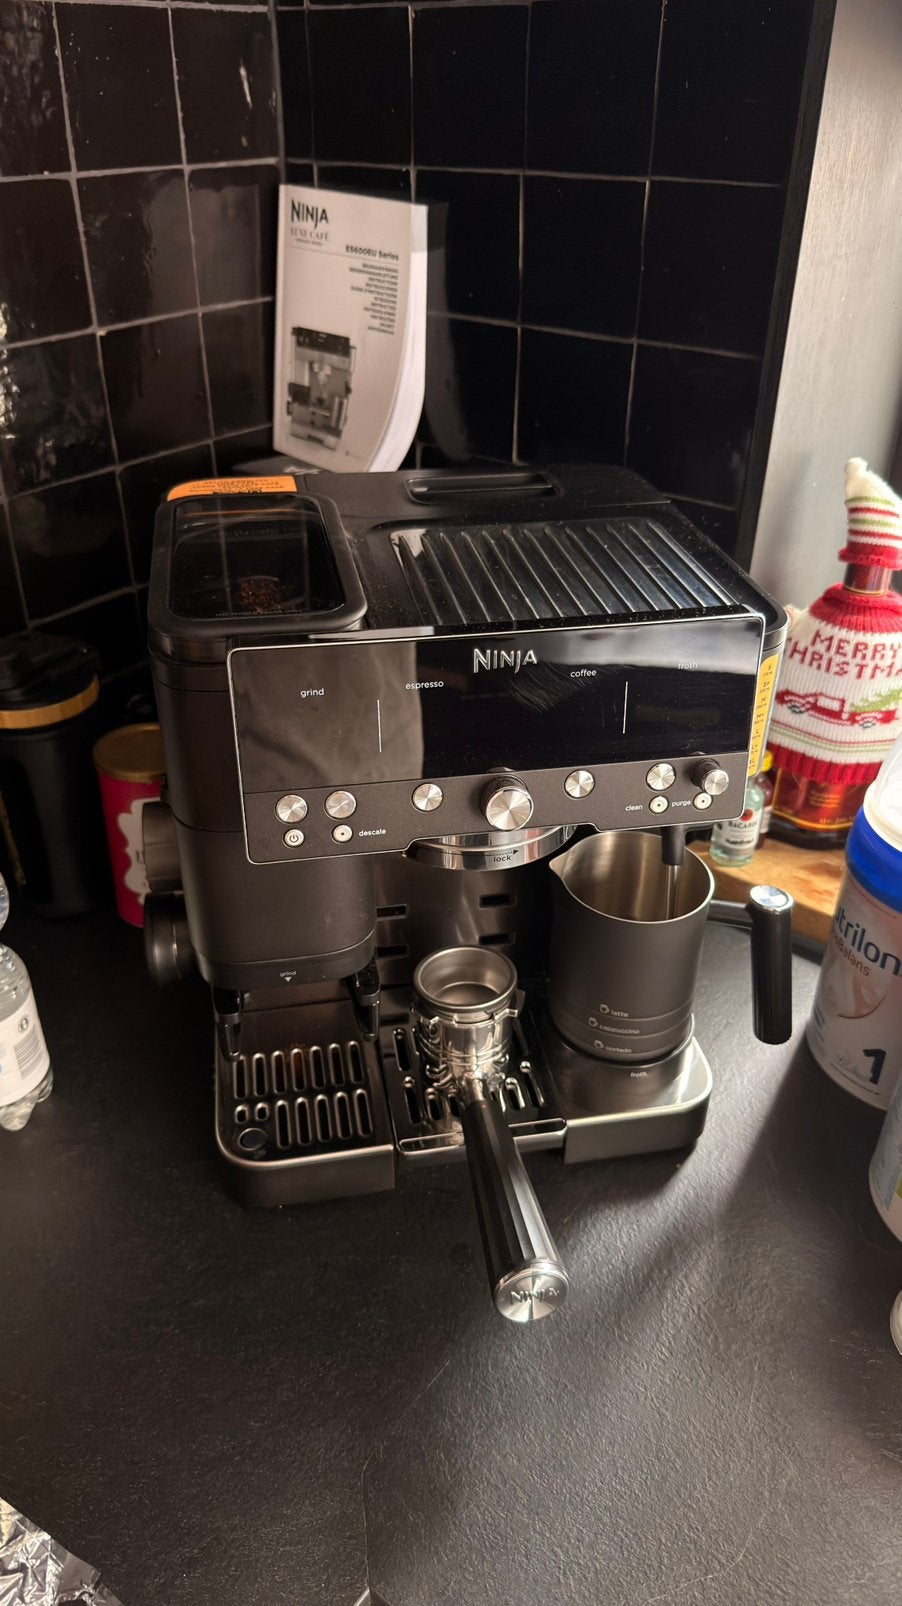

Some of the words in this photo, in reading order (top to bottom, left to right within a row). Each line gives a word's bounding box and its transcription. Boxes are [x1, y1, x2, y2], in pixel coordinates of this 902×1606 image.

[291, 199, 329, 230] NINJA
[378, 250, 399, 261] Series
[811, 629, 902, 662] MERRY
[473, 648, 538, 674] NINJA
[570, 668, 597, 678] coffee
[405, 680, 444, 690] espresso
[300, 687, 325, 698] grind
[358, 828, 387, 837] descale
[493, 854, 511, 863] lock
[610, 1009, 629, 1018] latte
[599, 1023, 640, 1035] cappuccino
[863, 1048, 887, 1085] 1
